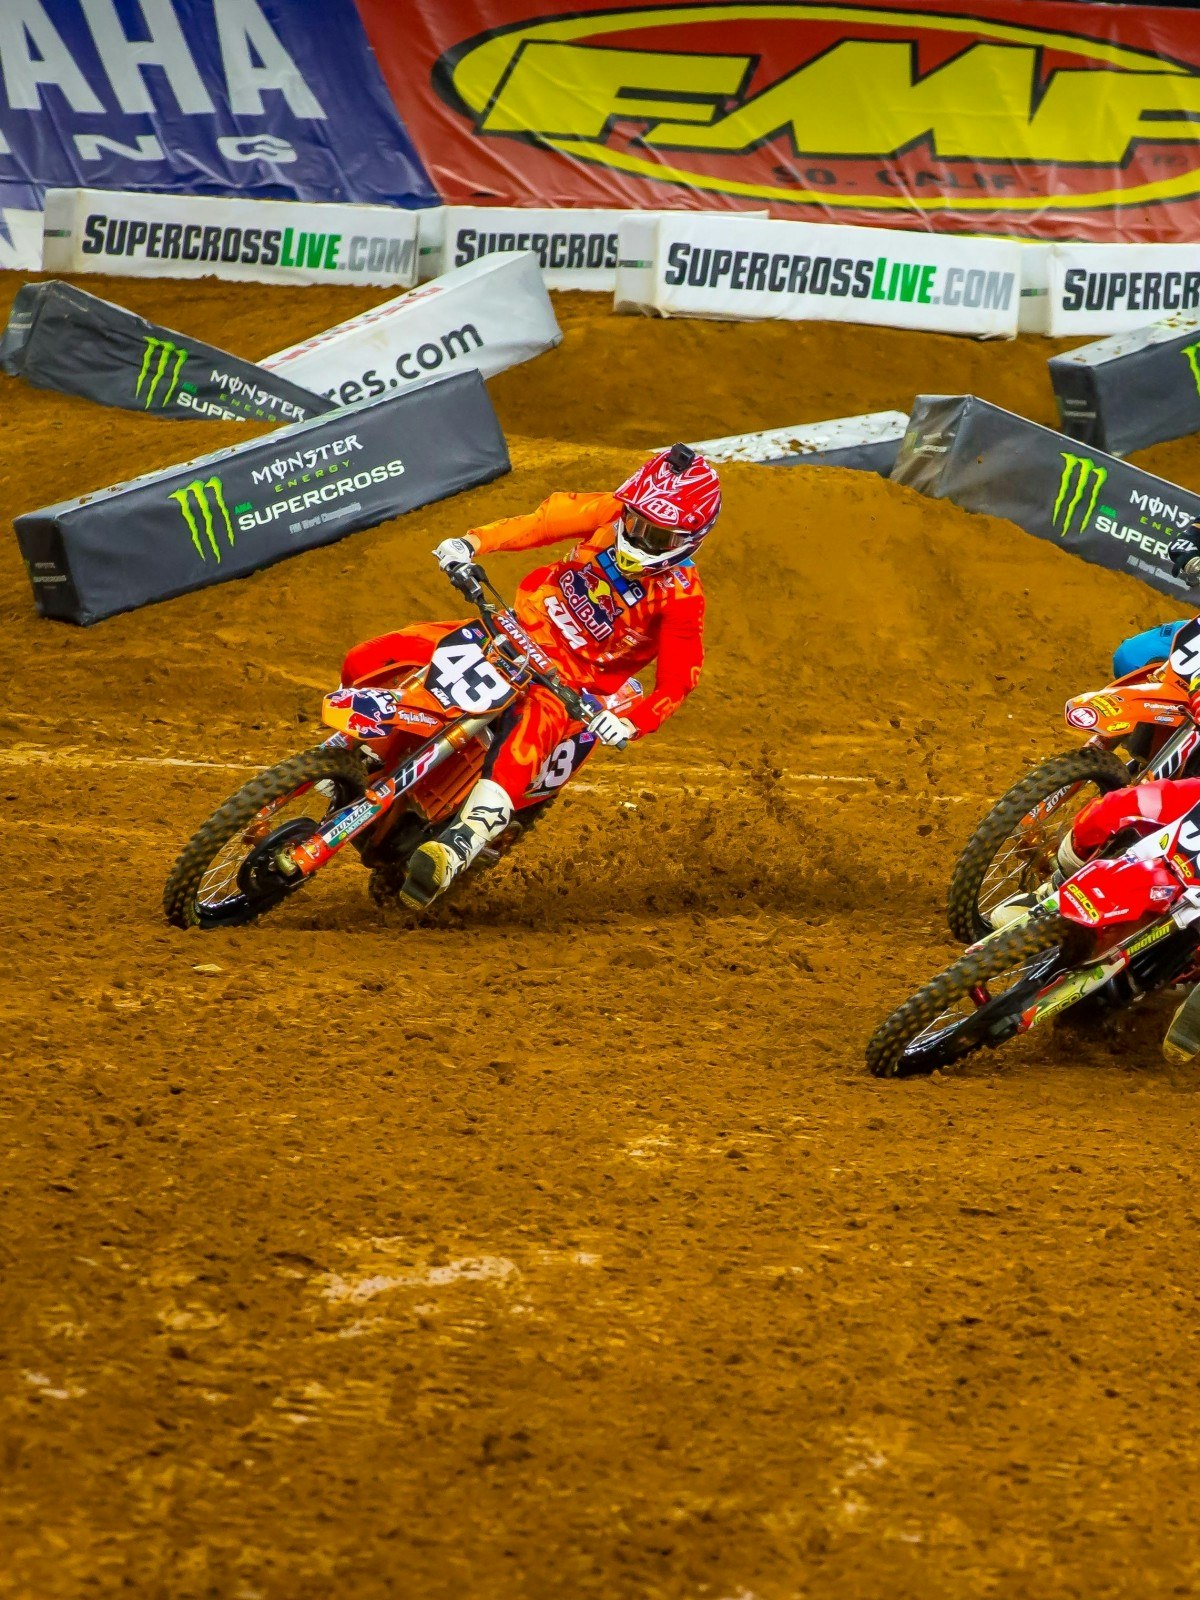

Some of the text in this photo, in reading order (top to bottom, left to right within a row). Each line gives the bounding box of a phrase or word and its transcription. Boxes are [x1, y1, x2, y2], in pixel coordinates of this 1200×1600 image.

[82, 214, 415, 274] SUPERCROSSLIVE.COM
[664, 242, 1015, 310] SUPERCROSSLIVE.COM
[210, 370, 305, 423] MONSTER
[252, 434, 363, 486] MONSTER
[275, 460, 351, 493] ENERGY
[238, 459, 405, 531] SUPERCROSS
[497, 616, 549, 670] RENTHAL
[544, 596, 587, 650] KTM
[430, 687, 451, 706] KTM
[431, 643, 511, 713] 43
[330, 803, 372, 838] DUNLOP
[1067, 884, 1099, 921] GEICO
